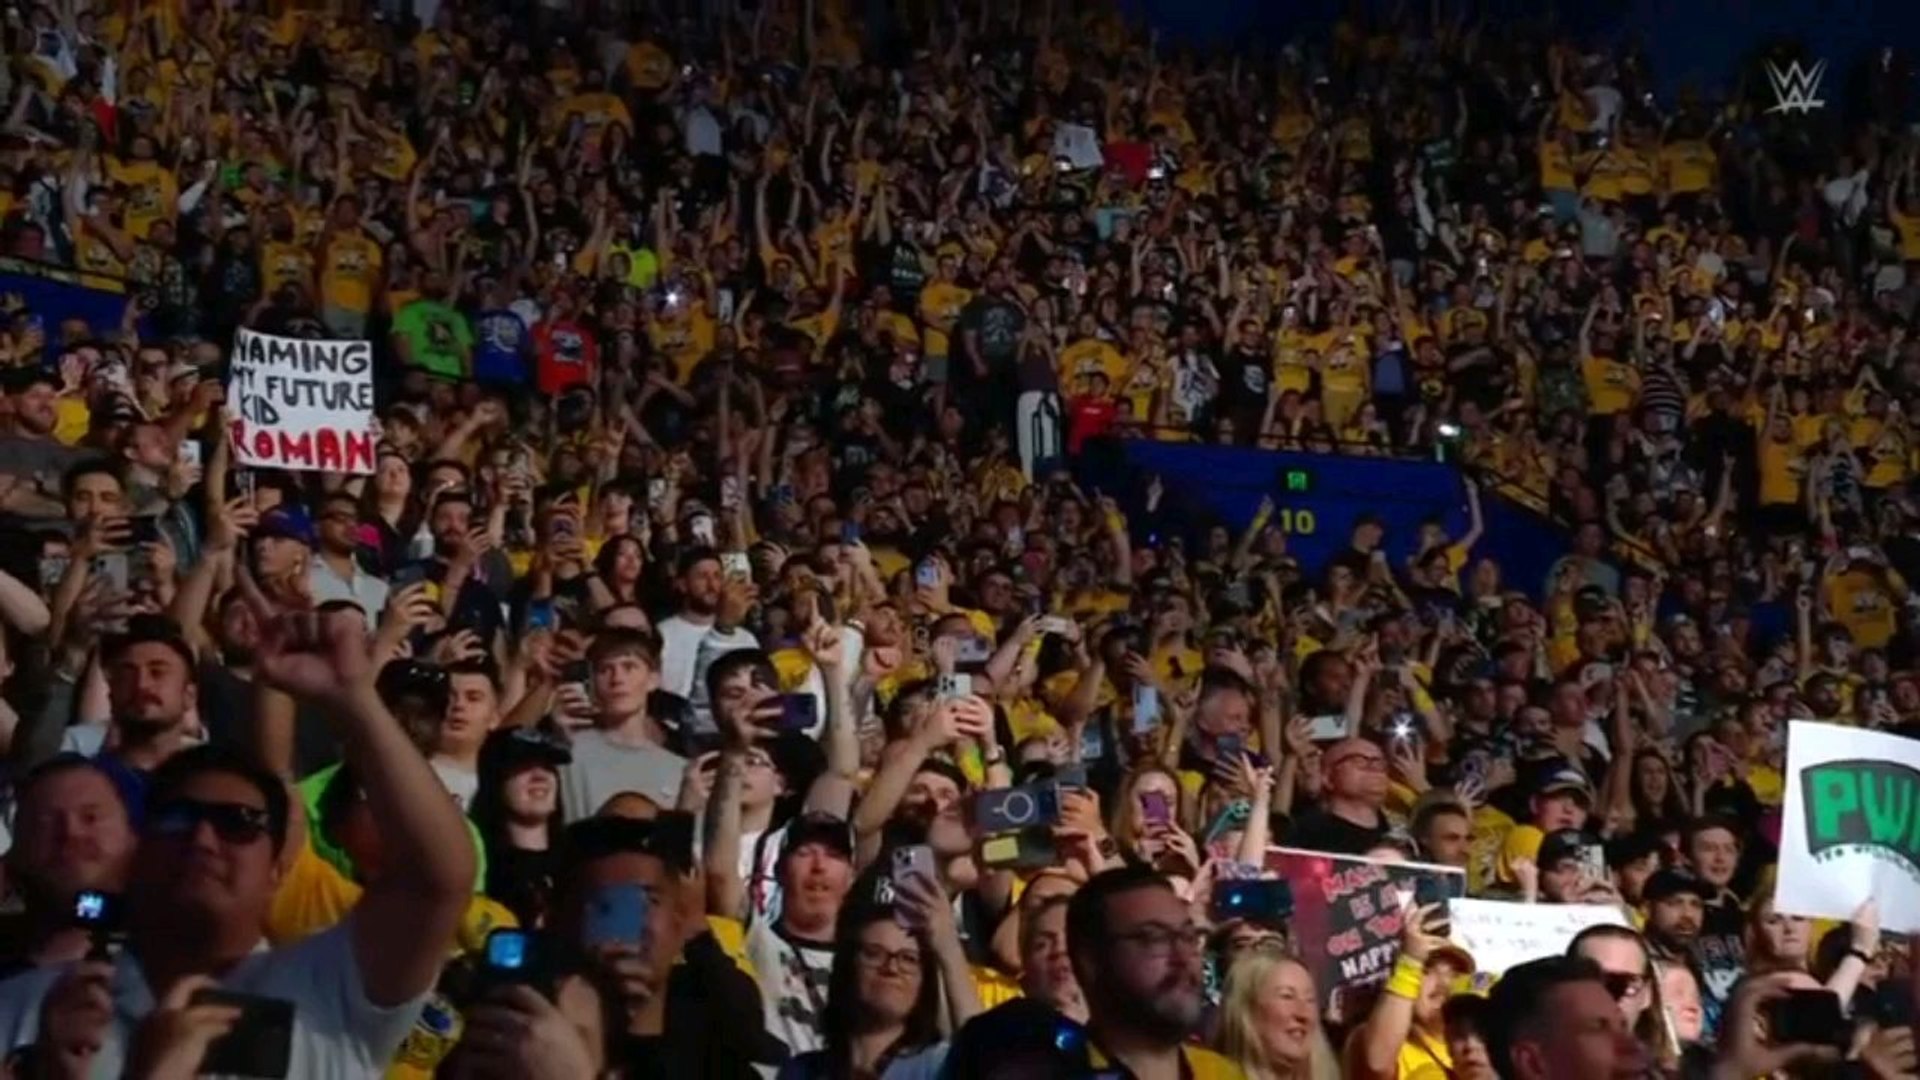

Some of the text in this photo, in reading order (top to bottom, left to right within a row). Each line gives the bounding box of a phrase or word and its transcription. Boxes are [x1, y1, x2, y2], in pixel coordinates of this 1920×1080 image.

[233, 334, 368, 375] NAMING
[241, 394, 280, 425] KID
[265, 376, 373, 411] FUTURE
[230, 419, 373, 470] ROMAN
[1281, 509, 1316, 535] 10
[1811, 767, 1920, 852] PW
